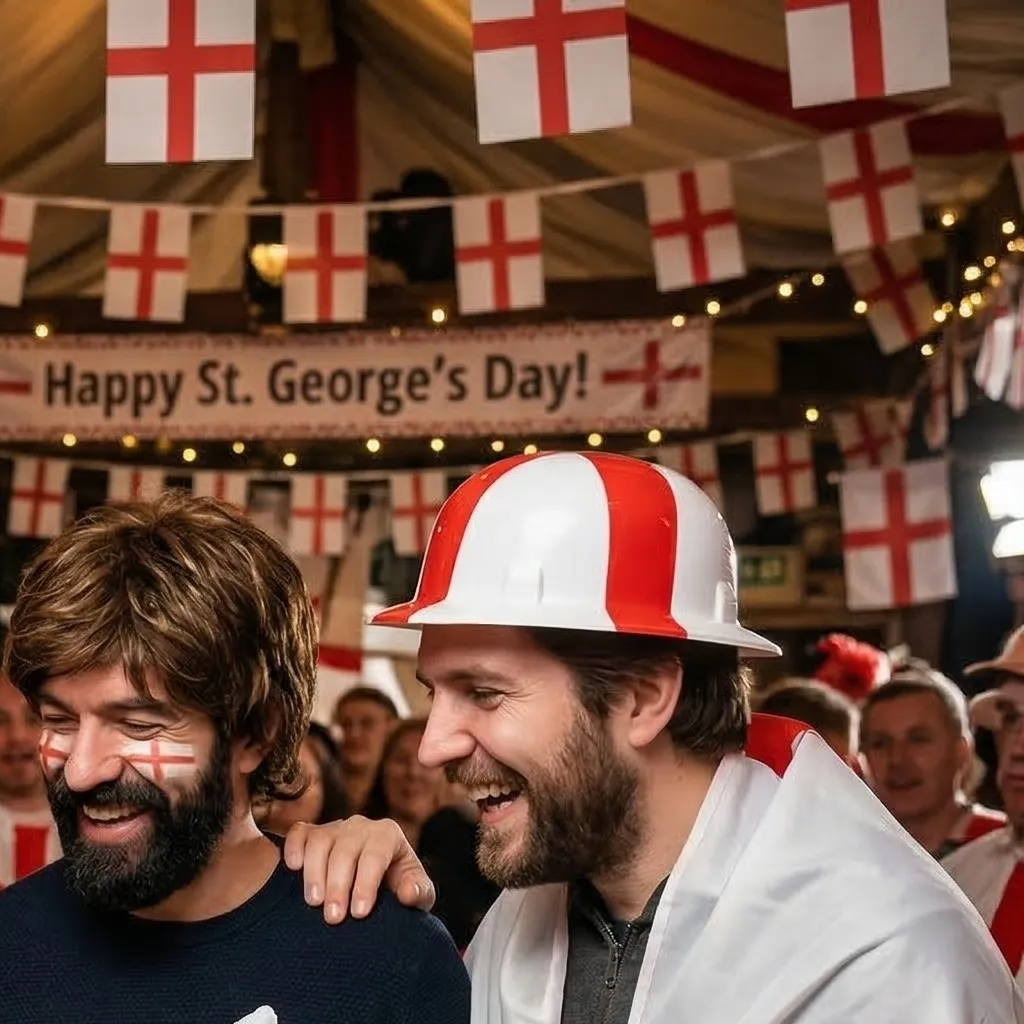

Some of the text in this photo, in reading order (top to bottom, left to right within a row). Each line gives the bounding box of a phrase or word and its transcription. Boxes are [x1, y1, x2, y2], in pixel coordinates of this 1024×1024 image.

[45, 351, 589, 418] Happy St. George’s Day!
